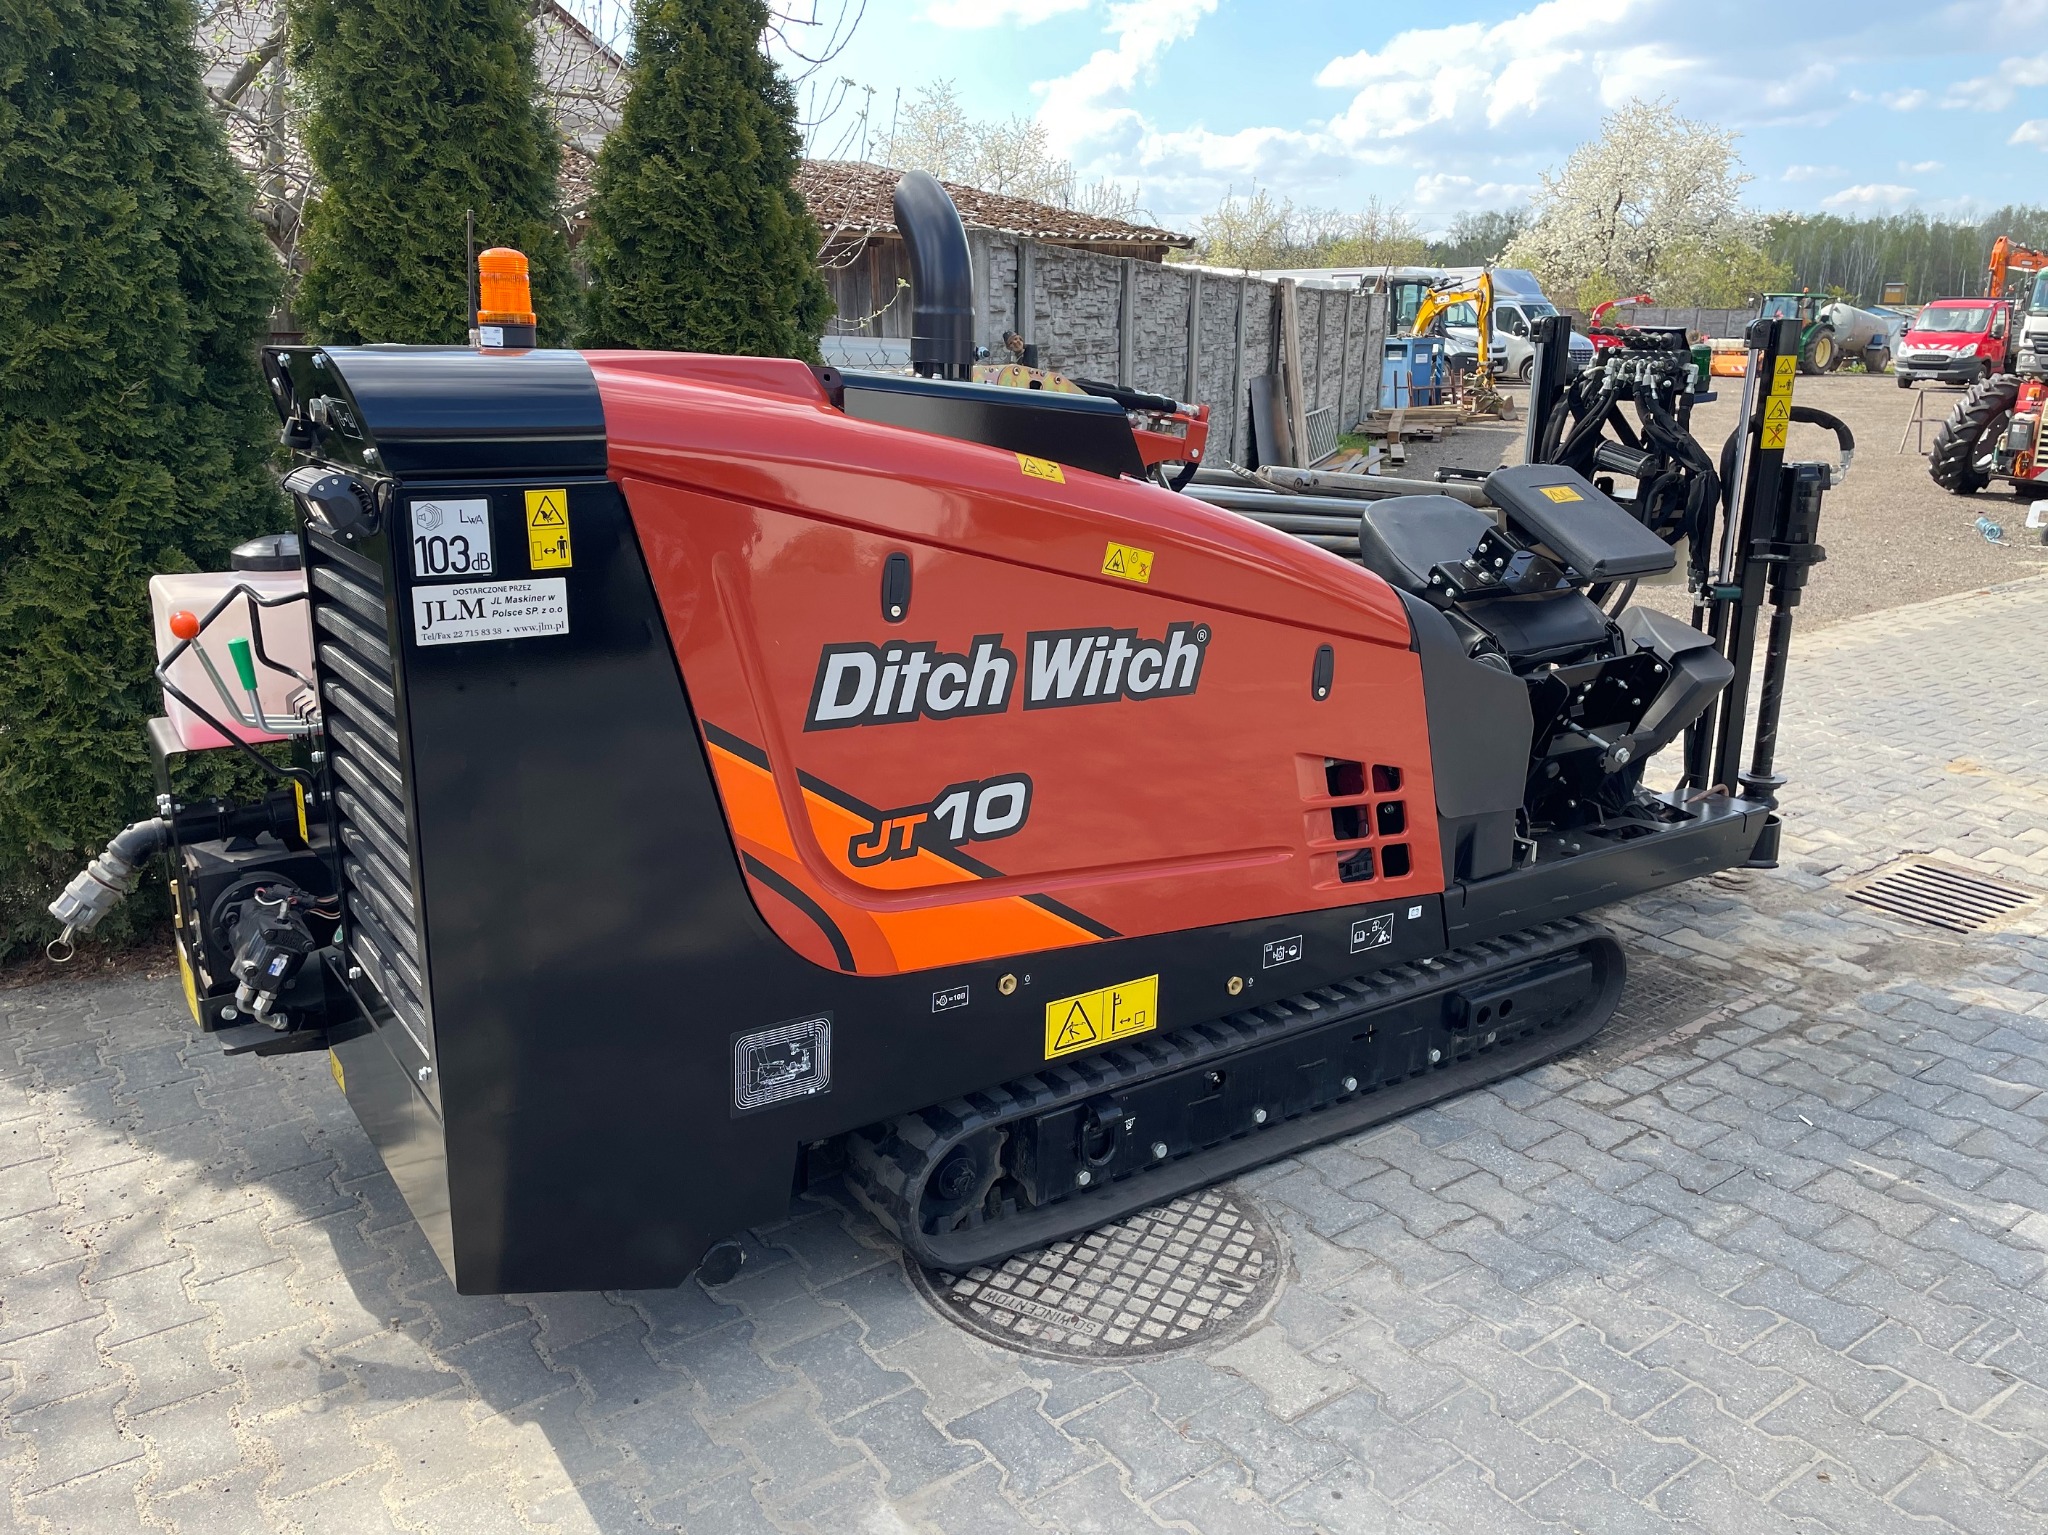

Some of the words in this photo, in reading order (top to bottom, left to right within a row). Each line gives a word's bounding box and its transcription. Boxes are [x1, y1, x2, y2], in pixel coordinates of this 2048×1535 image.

[414, 535, 471, 575] 103
[471, 552, 491, 571] dB
[452, 586, 507, 596] DOSTARCZONE
[509, 584, 532, 592] PRZEZ
[490, 597, 502, 605] JL
[504, 594, 546, 604] Maskiner
[421, 597, 487, 631] JLM
[492, 608, 523, 618] Polsce
[525, 607, 539, 615] SP.
[421, 631, 451, 641] Tel/Fax
[465, 629, 479, 637] 715
[481, 628, 491, 636] 83
[492, 627, 502, 635] 38
[513, 620, 565, 633] www.jlm.pl
[814, 643, 1010, 721] Ditch
